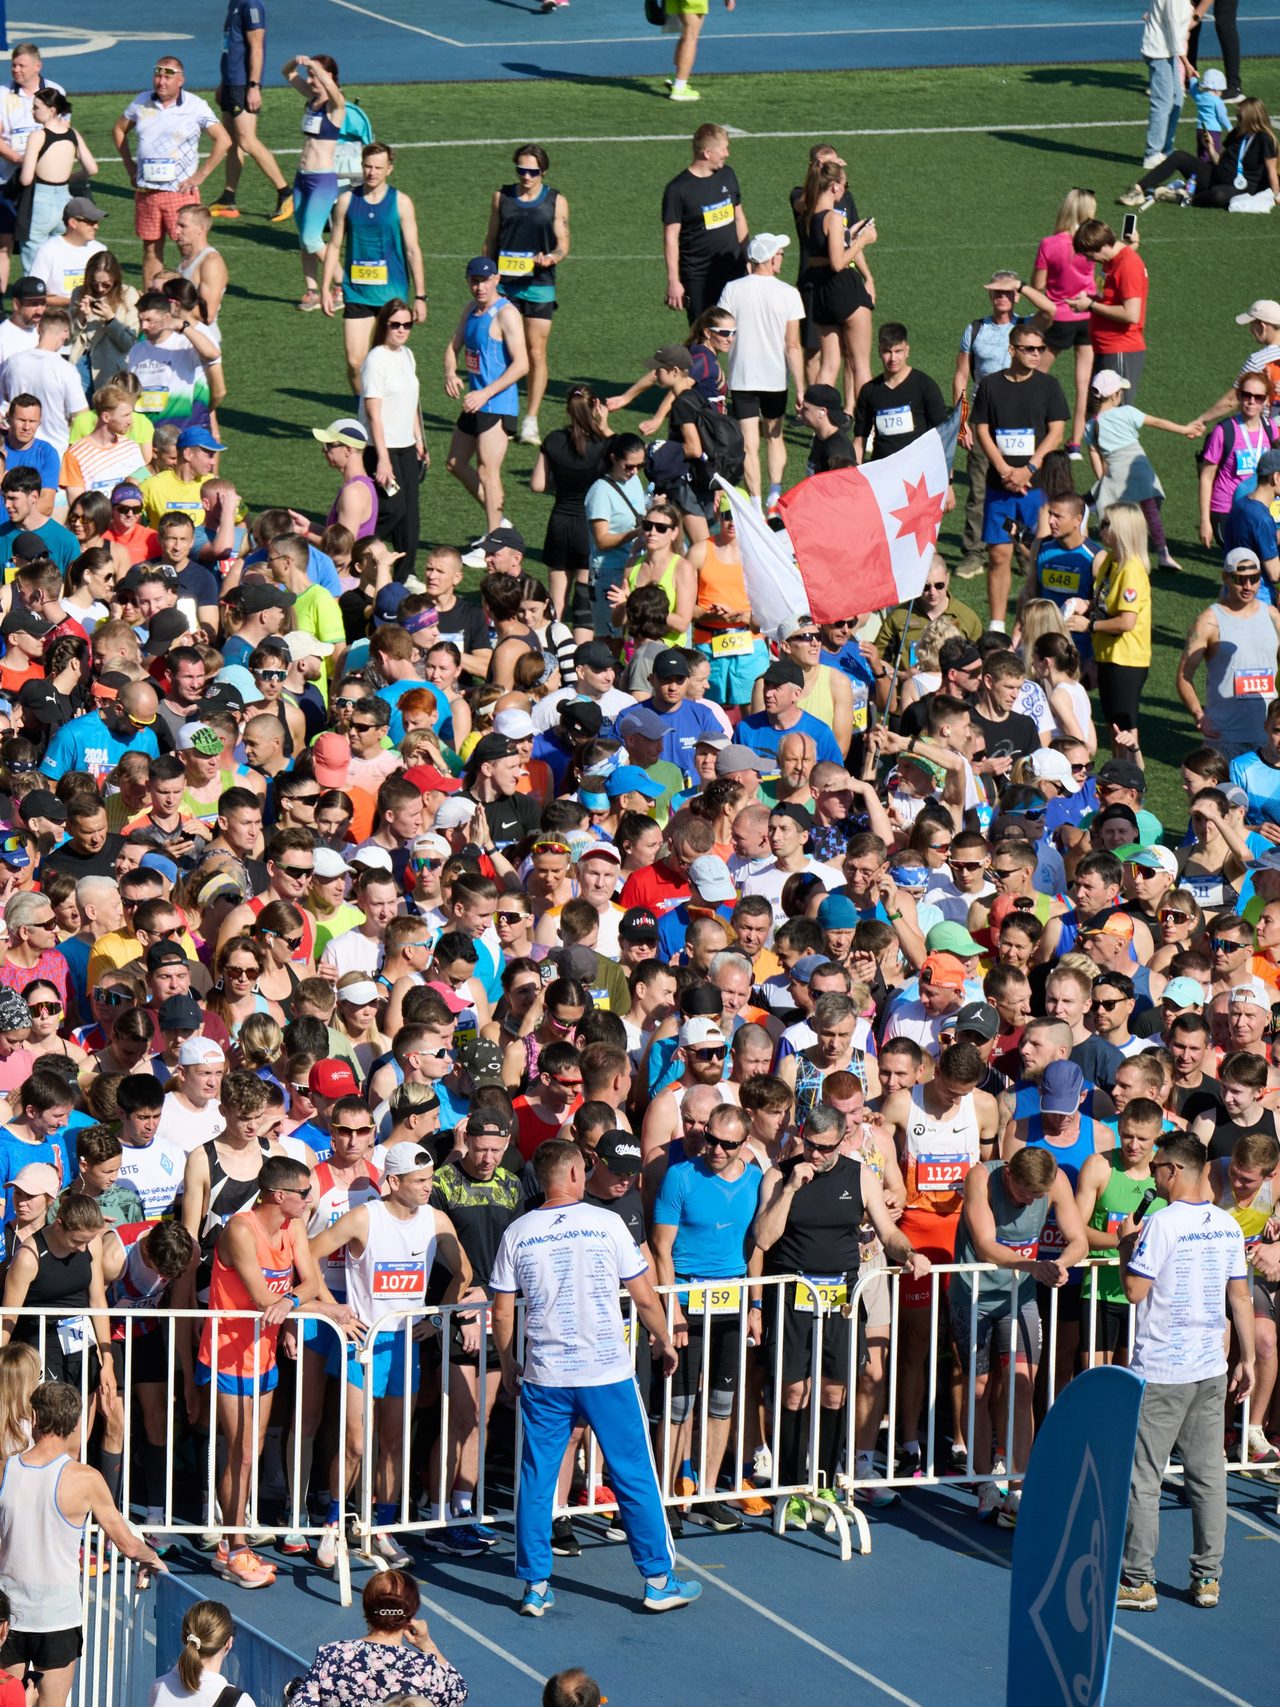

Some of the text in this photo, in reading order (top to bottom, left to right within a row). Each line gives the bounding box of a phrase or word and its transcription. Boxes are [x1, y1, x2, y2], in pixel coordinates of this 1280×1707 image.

[713, 212, 729, 222] 836
[506, 259, 526, 270] 778
[358, 269, 380, 279] 595
[884, 417, 903, 428] 178
[1004, 438, 1025, 448] 176
[1048, 573, 1072, 586] 648
[722, 636, 744, 648] 692
[1241, 679, 1269, 692] 1113
[84, 748, 107, 763] 2024
[120, 1165, 139, 1176] ВТБ
[927, 1166, 961, 1181] 1122
[381, 1275, 418, 1290] 1077
[906, 1291, 930, 1300] INEOS
